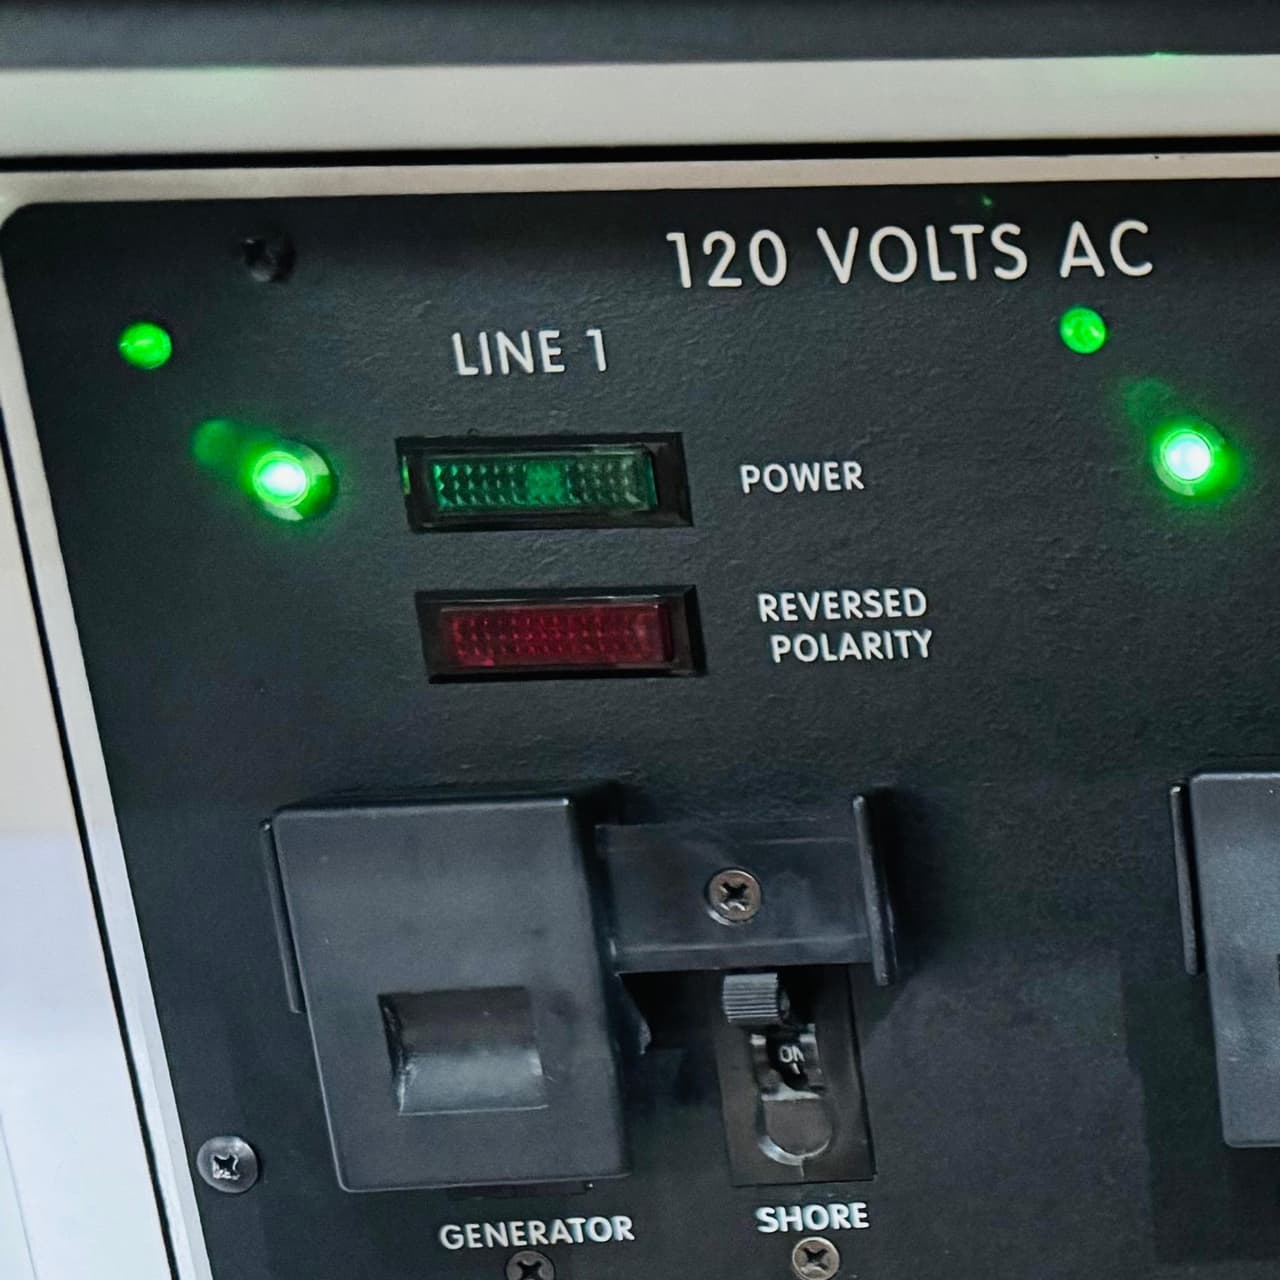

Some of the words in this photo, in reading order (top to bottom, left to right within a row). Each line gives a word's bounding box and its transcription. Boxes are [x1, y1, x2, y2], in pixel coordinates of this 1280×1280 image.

[667, 229, 787, 288] 120
[817, 224, 1028, 284] VOLTS
[1060, 220, 1153, 278] AC
[453, 331, 566, 377] LINE
[588, 330, 608, 372] 1
[741, 461, 865, 494] POWER
[758, 587, 927, 622] REVERSED
[771, 630, 932, 663] POLARITY
[439, 1215, 634, 1250] GENERATOR
[756, 1202, 870, 1233] SHORE
